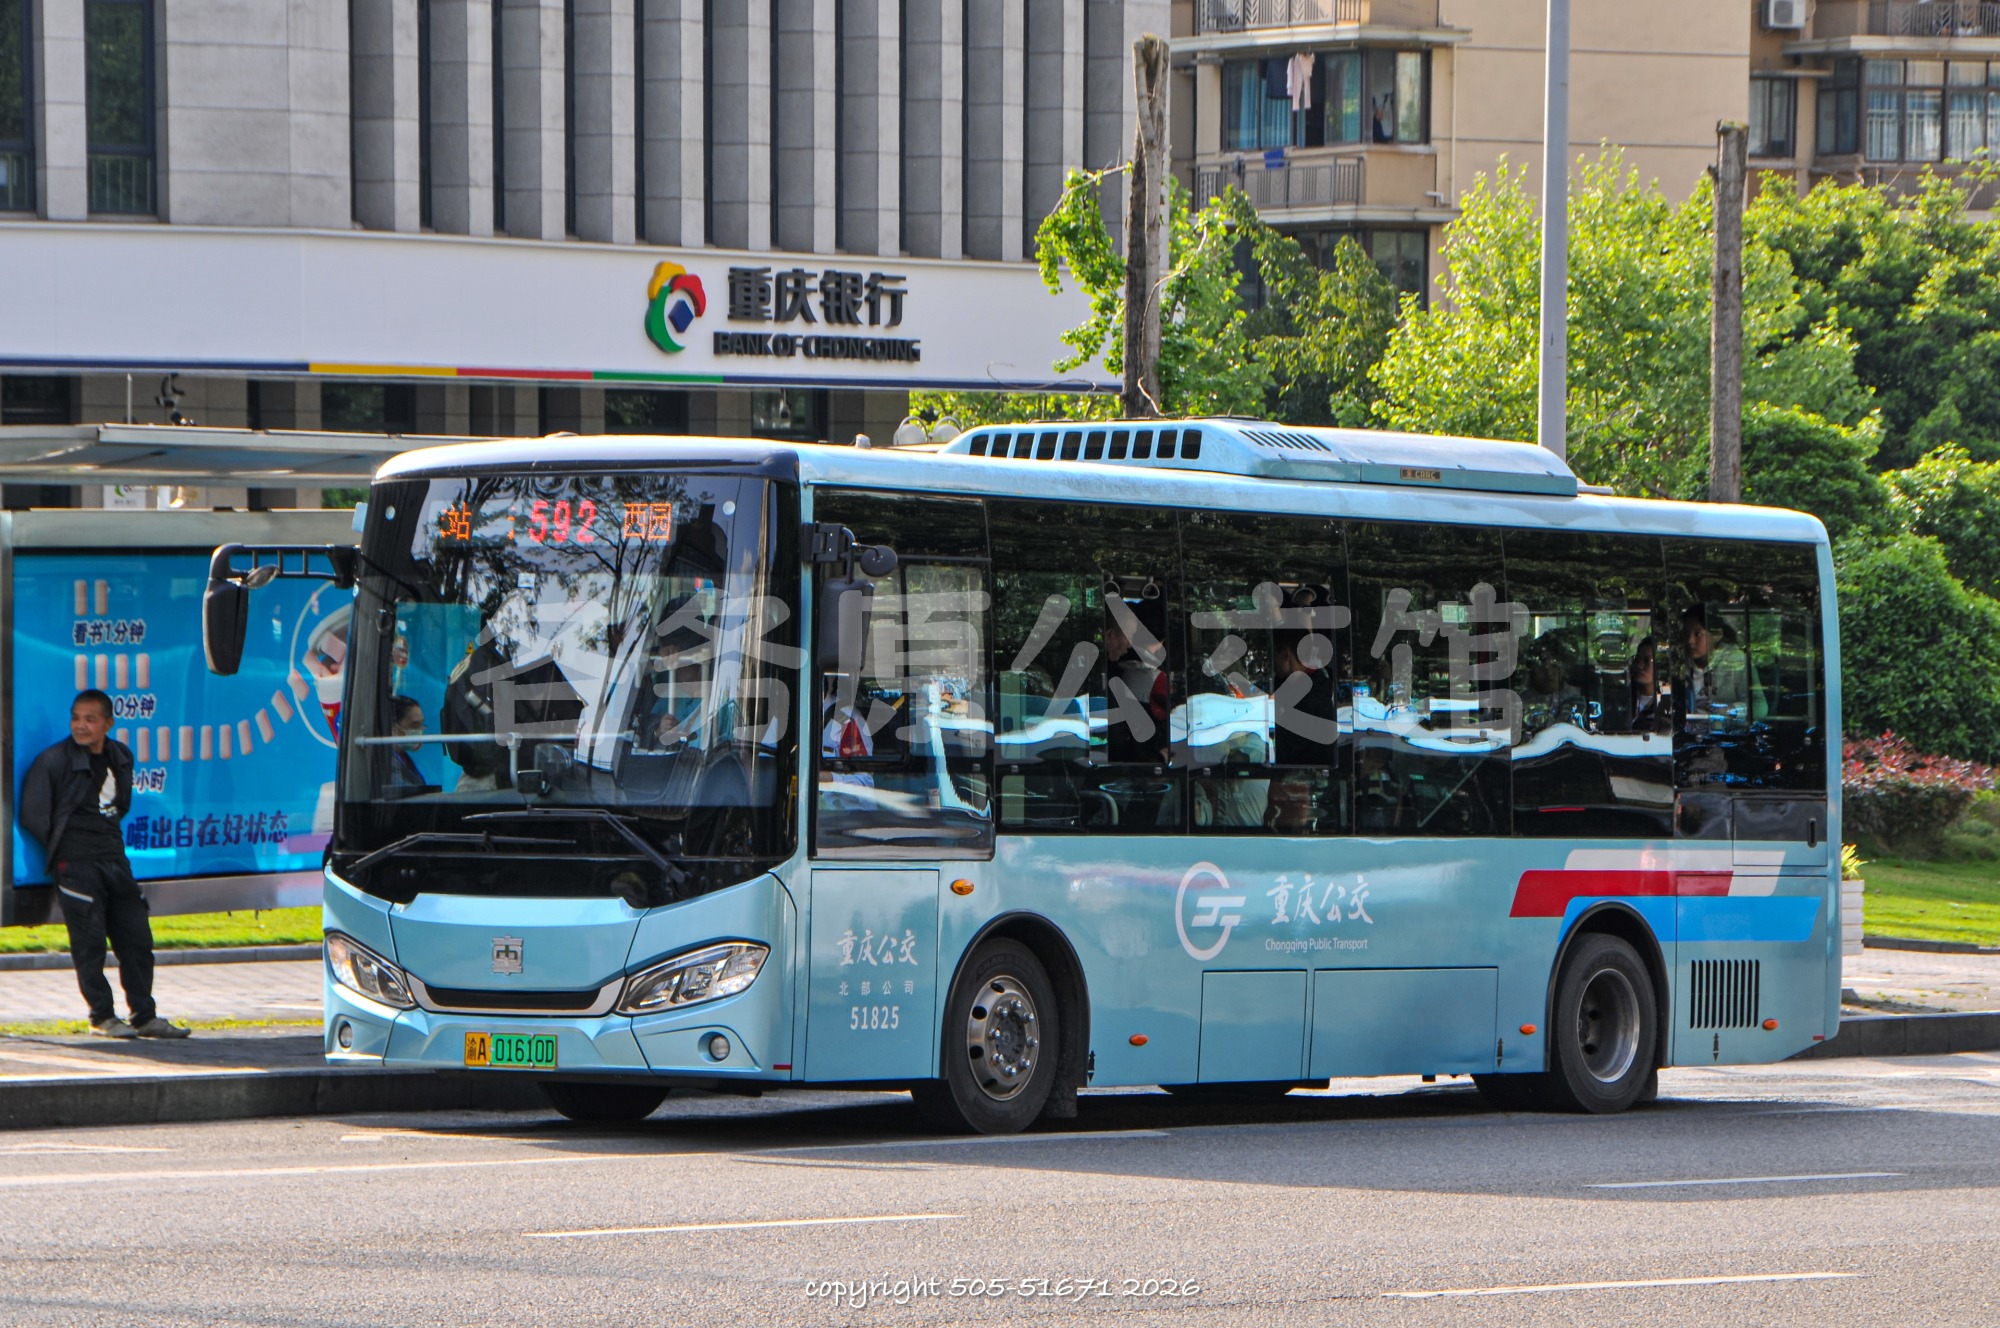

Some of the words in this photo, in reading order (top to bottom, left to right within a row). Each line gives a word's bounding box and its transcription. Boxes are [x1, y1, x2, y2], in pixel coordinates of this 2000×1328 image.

[727, 266, 908, 327] 重庆银行
[713, 332, 773, 356] BANK
[772, 333, 803, 357] OF
[803, 335, 921, 362] CHONGQING
[1414, 470, 1436, 480] CRRC
[528, 500, 597, 542] 592
[623, 503, 673, 541] 西园
[111, 694, 156, 718] 0分钟
[132, 768, 166, 792] 小时
[126, 810, 288, 850] 嚼出自在好状态
[1266, 873, 1374, 925] 重庆公交
[836, 929, 918, 966] 重庆公交
[1265, 938, 1308, 953] Chongqing
[1309, 938, 1332, 950] Public
[1333, 938, 1368, 951] Transport
[839, 980, 914, 996] 北部公司
[850, 1006, 900, 1030] 51825
